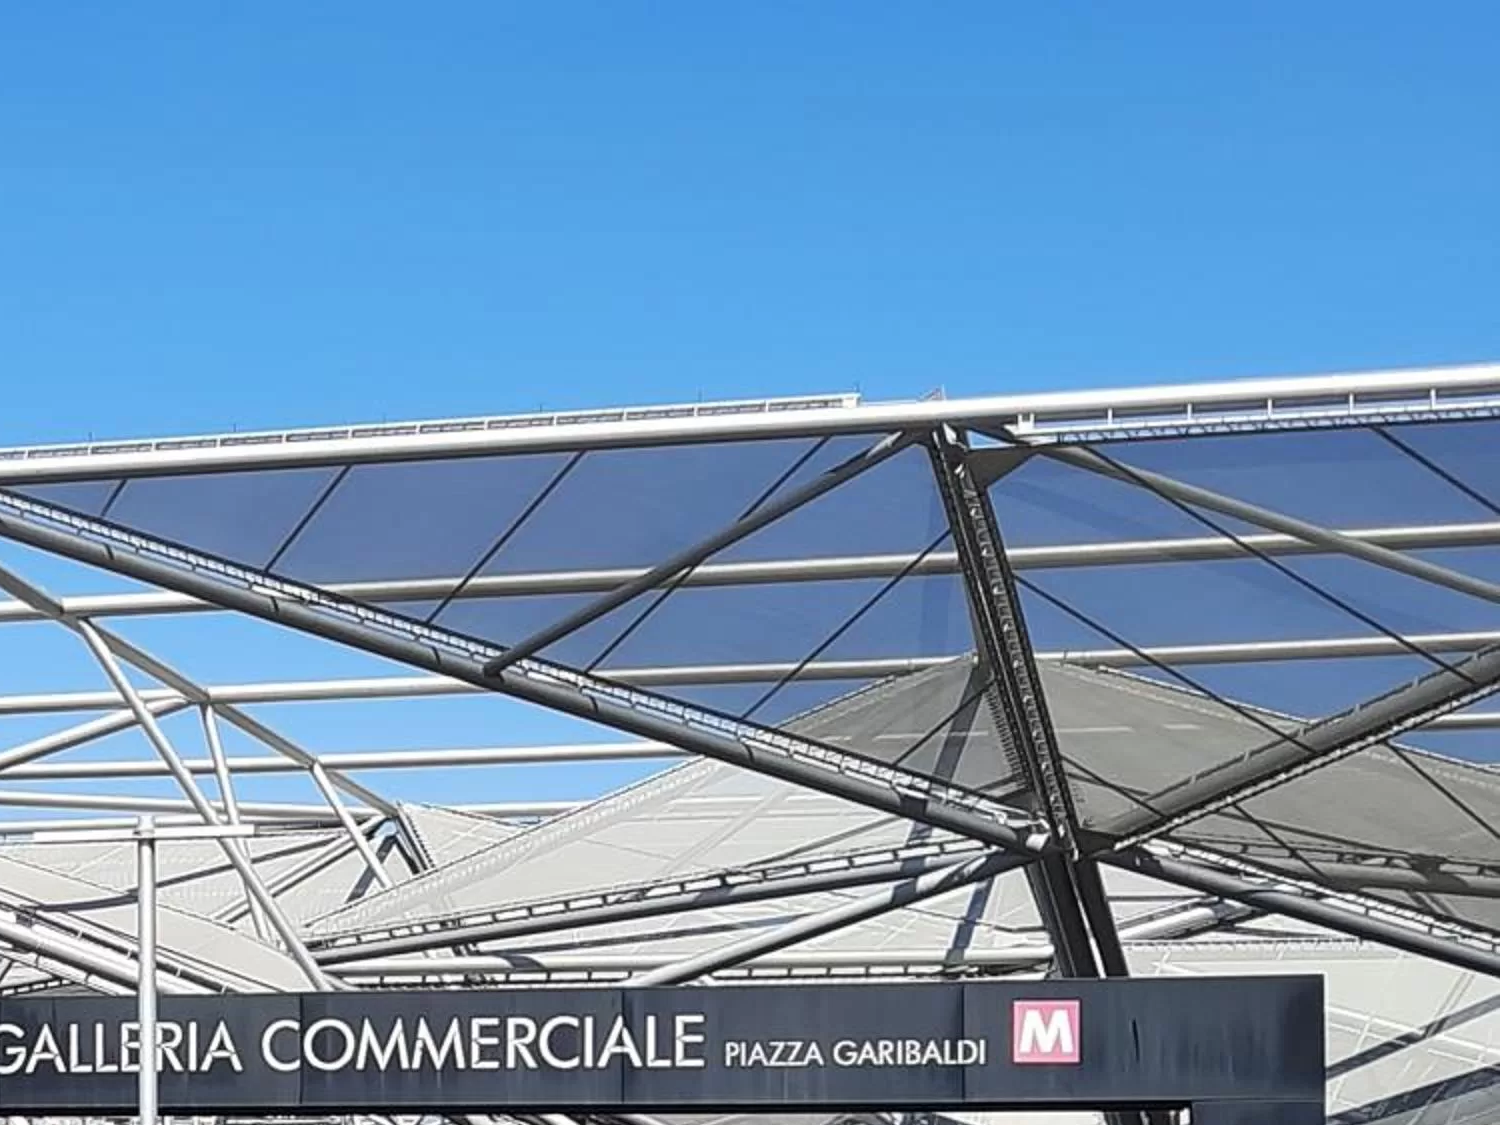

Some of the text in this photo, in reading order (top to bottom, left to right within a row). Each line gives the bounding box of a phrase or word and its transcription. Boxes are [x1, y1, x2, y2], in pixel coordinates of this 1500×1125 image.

[261, 1015, 705, 1071] COMMERCIALE
[724, 1038, 987, 1067] PIAZZA GARIBALDI
[1018, 1008, 1074, 1054] M
